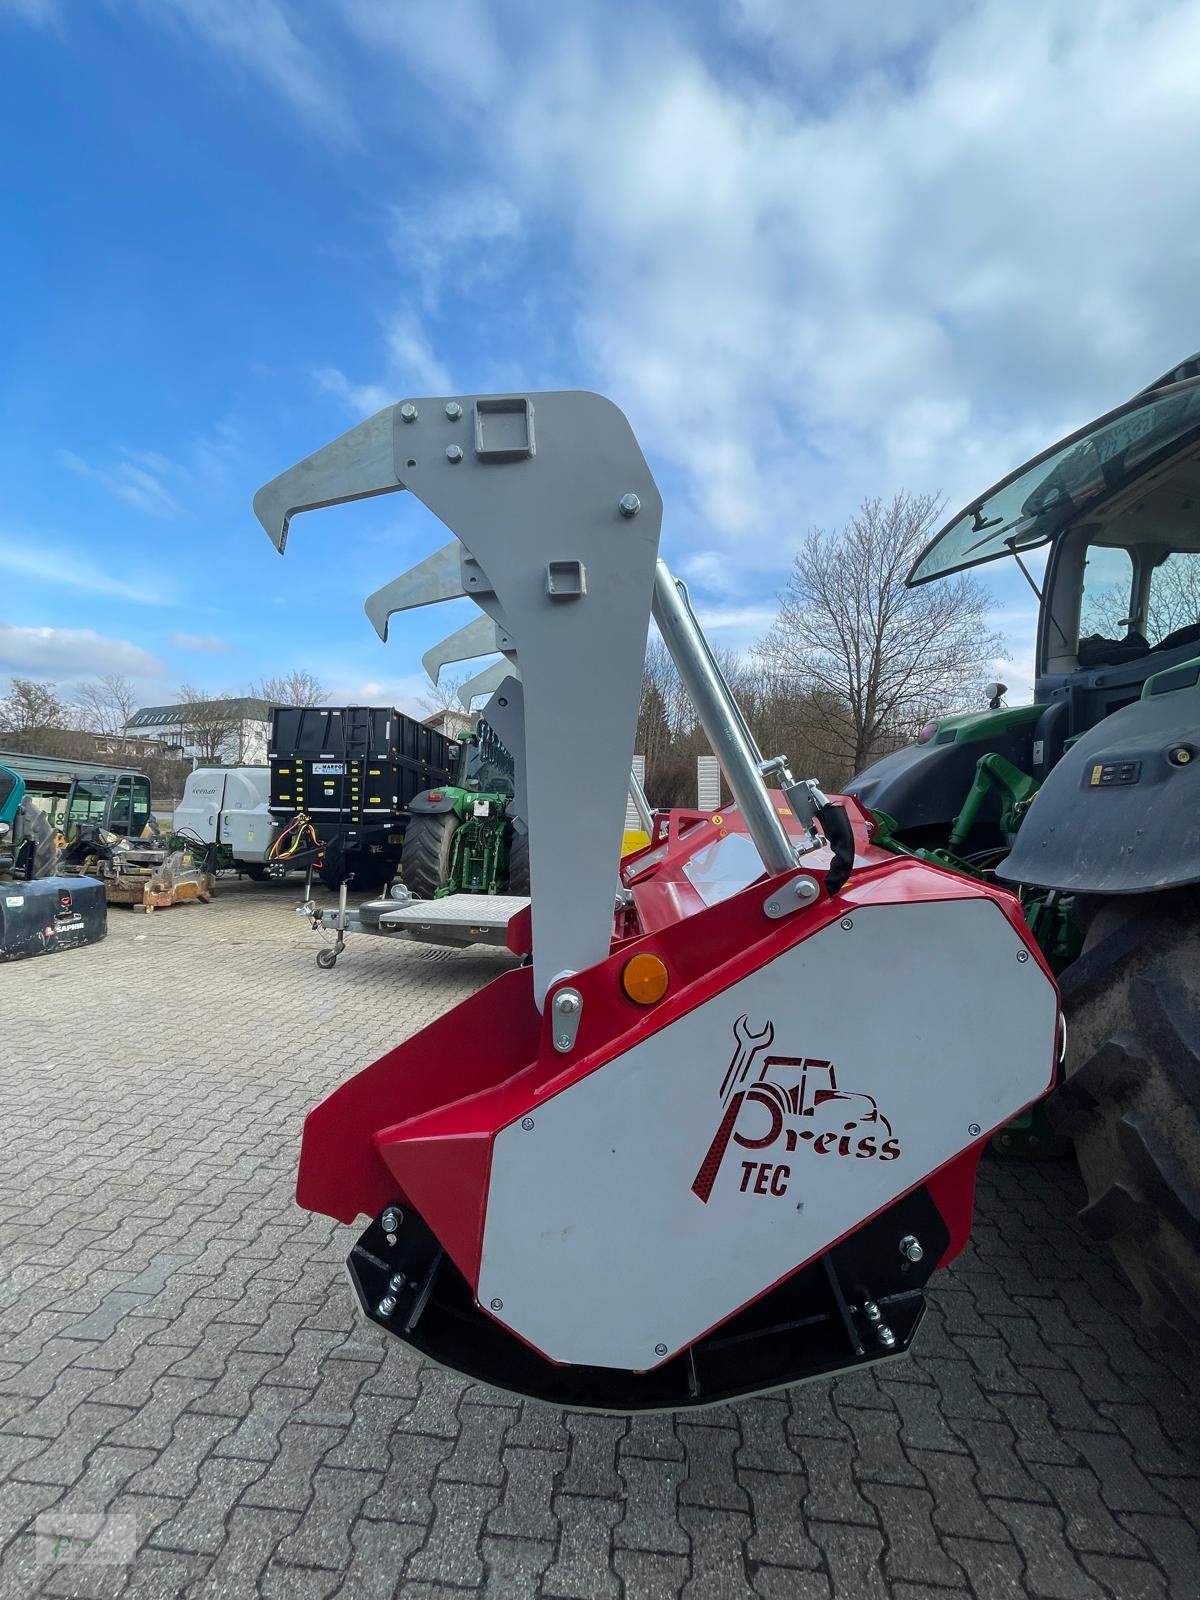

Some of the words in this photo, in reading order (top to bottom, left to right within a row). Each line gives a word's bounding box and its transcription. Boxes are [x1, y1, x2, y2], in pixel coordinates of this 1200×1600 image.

[56, 922, 84, 932] SAPHIR
[691, 1090, 901, 1204] Preiss
[739, 1161, 791, 1197] TEC
